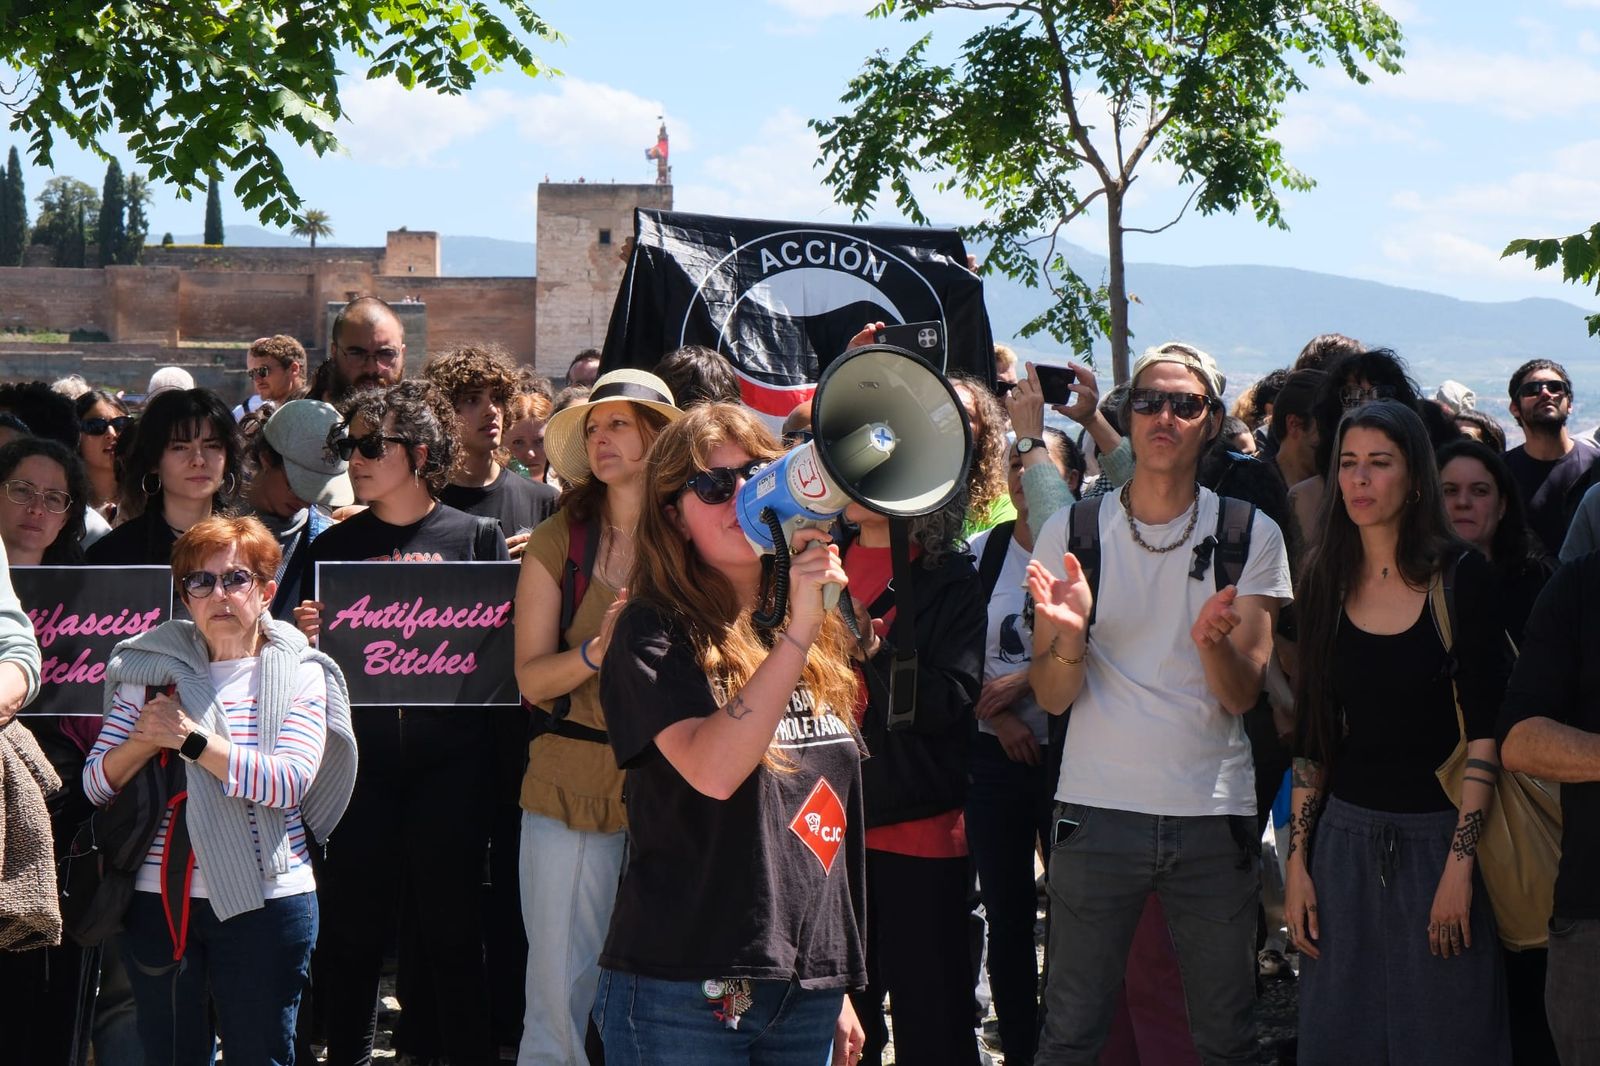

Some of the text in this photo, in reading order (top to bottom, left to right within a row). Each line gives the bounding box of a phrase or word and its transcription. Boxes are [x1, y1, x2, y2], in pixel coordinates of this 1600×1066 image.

[760, 240, 888, 283] ACCIÓN
[328, 594, 512, 640] Antifascist
[41, 648, 108, 684] tche
[363, 639, 478, 676] Bitches
[821, 826, 842, 842] CJC
